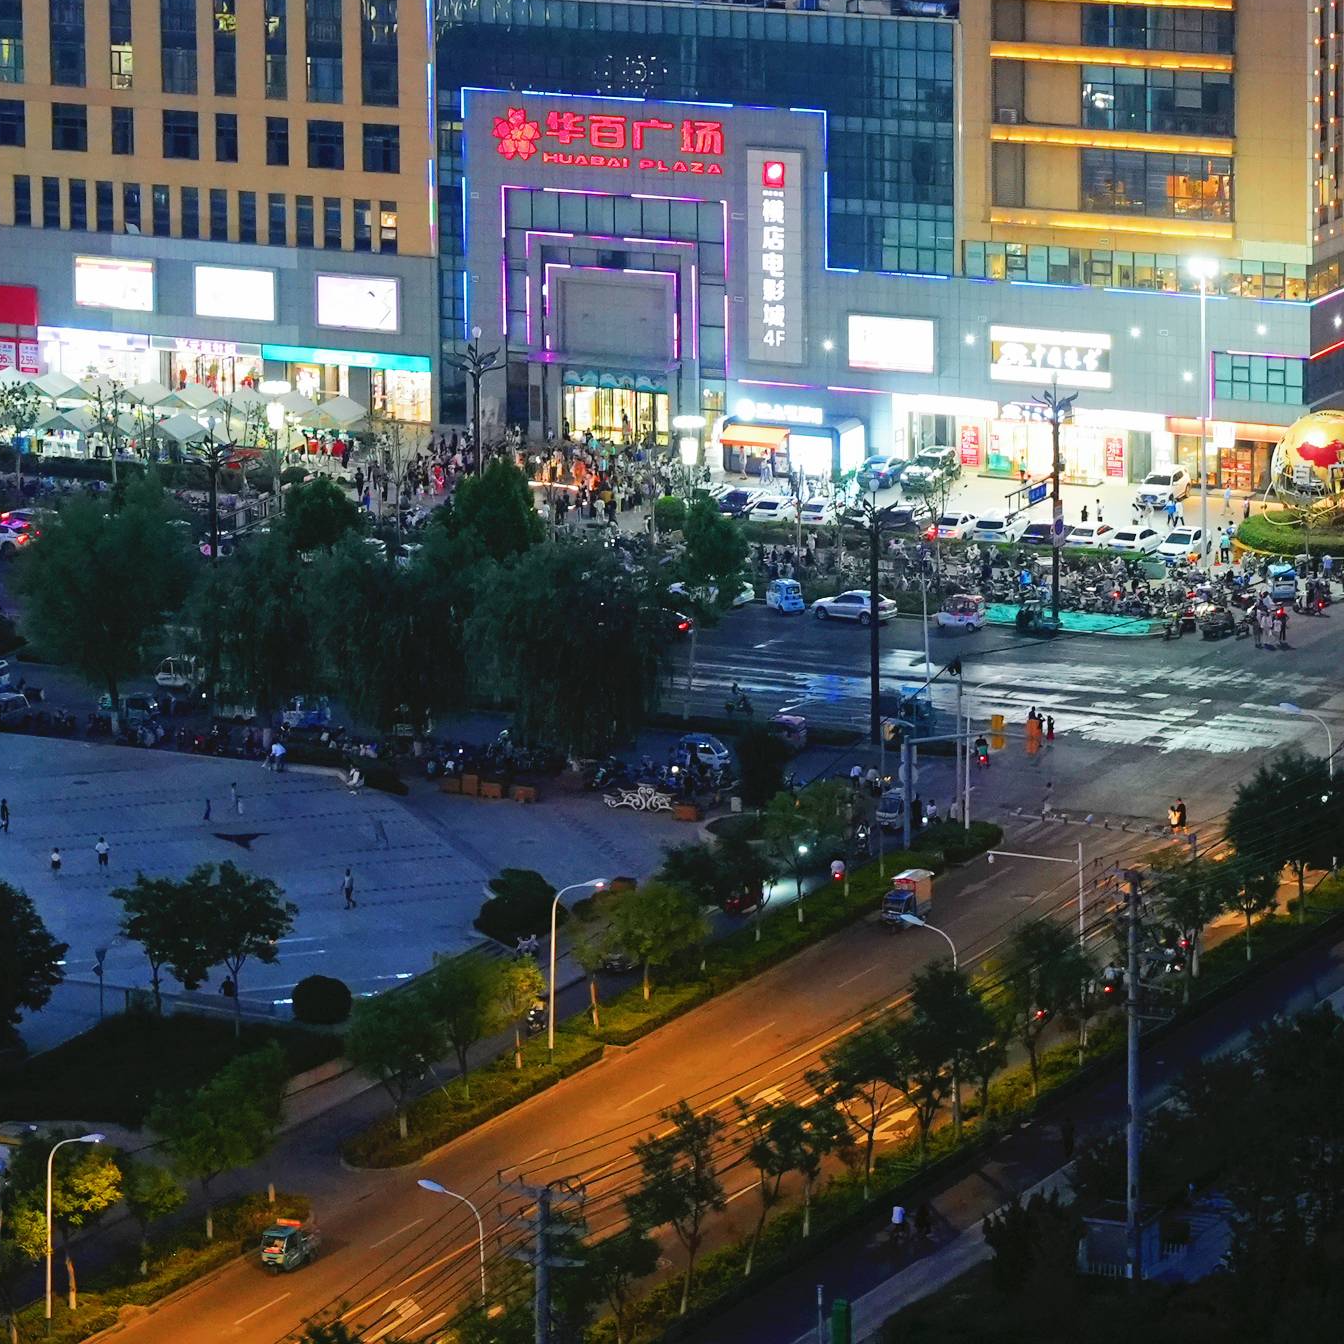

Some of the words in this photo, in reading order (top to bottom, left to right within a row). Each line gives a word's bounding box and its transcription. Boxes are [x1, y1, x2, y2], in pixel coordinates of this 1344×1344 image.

[545, 109, 725, 156] 华百广场
[542, 152, 629, 169] HUABAI
[638, 158, 723, 175] PLAZA
[761, 198, 786, 328] 横店电影城
